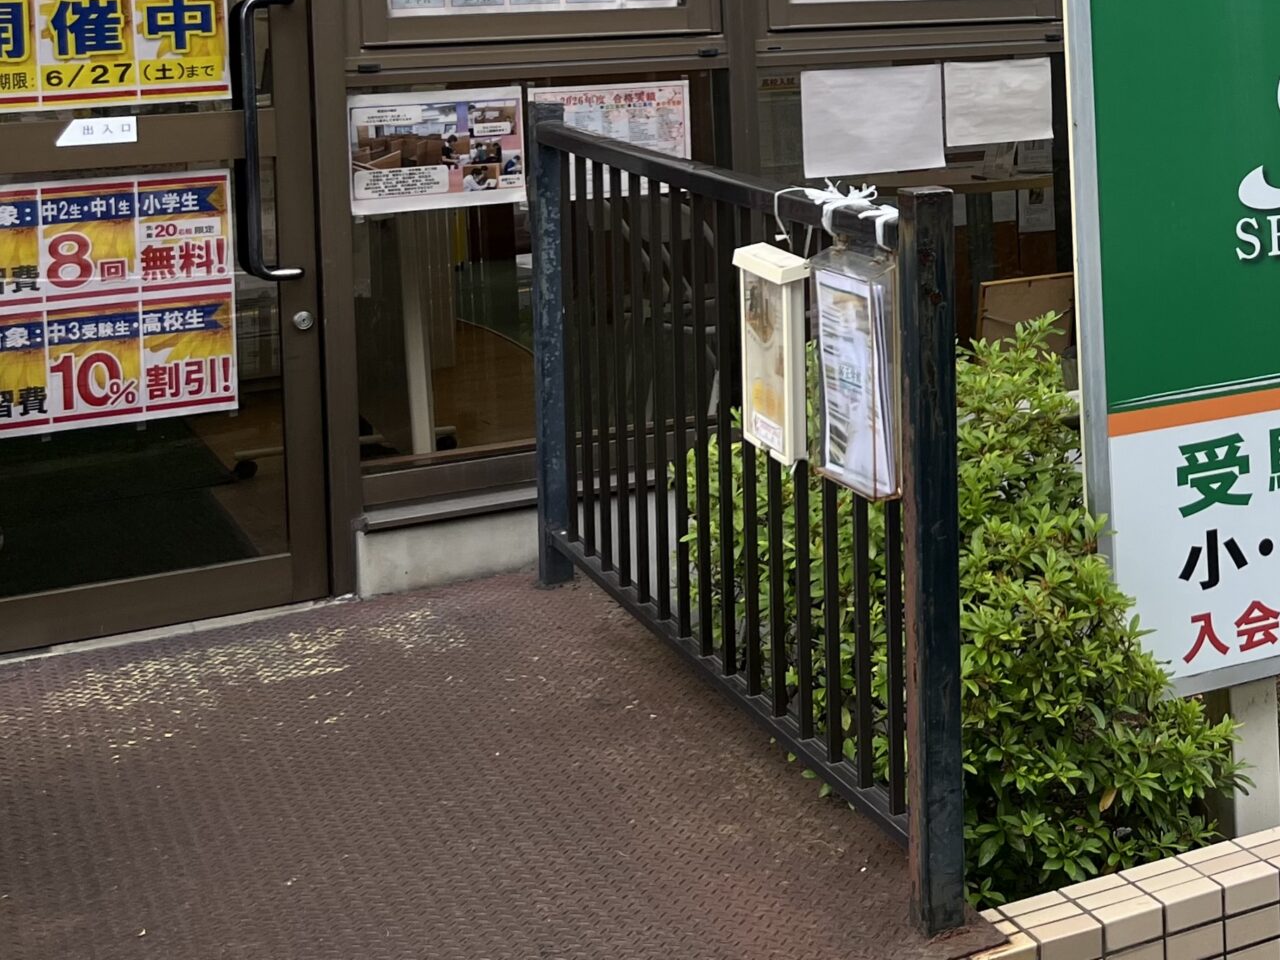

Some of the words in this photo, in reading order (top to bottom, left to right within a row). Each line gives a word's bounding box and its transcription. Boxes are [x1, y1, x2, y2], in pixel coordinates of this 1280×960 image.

[82, 123, 132, 136] 出入口
[47, 233, 127, 289] 8回
[51, 352, 136, 411] 10%
[146, 356, 231, 400] 割引!
